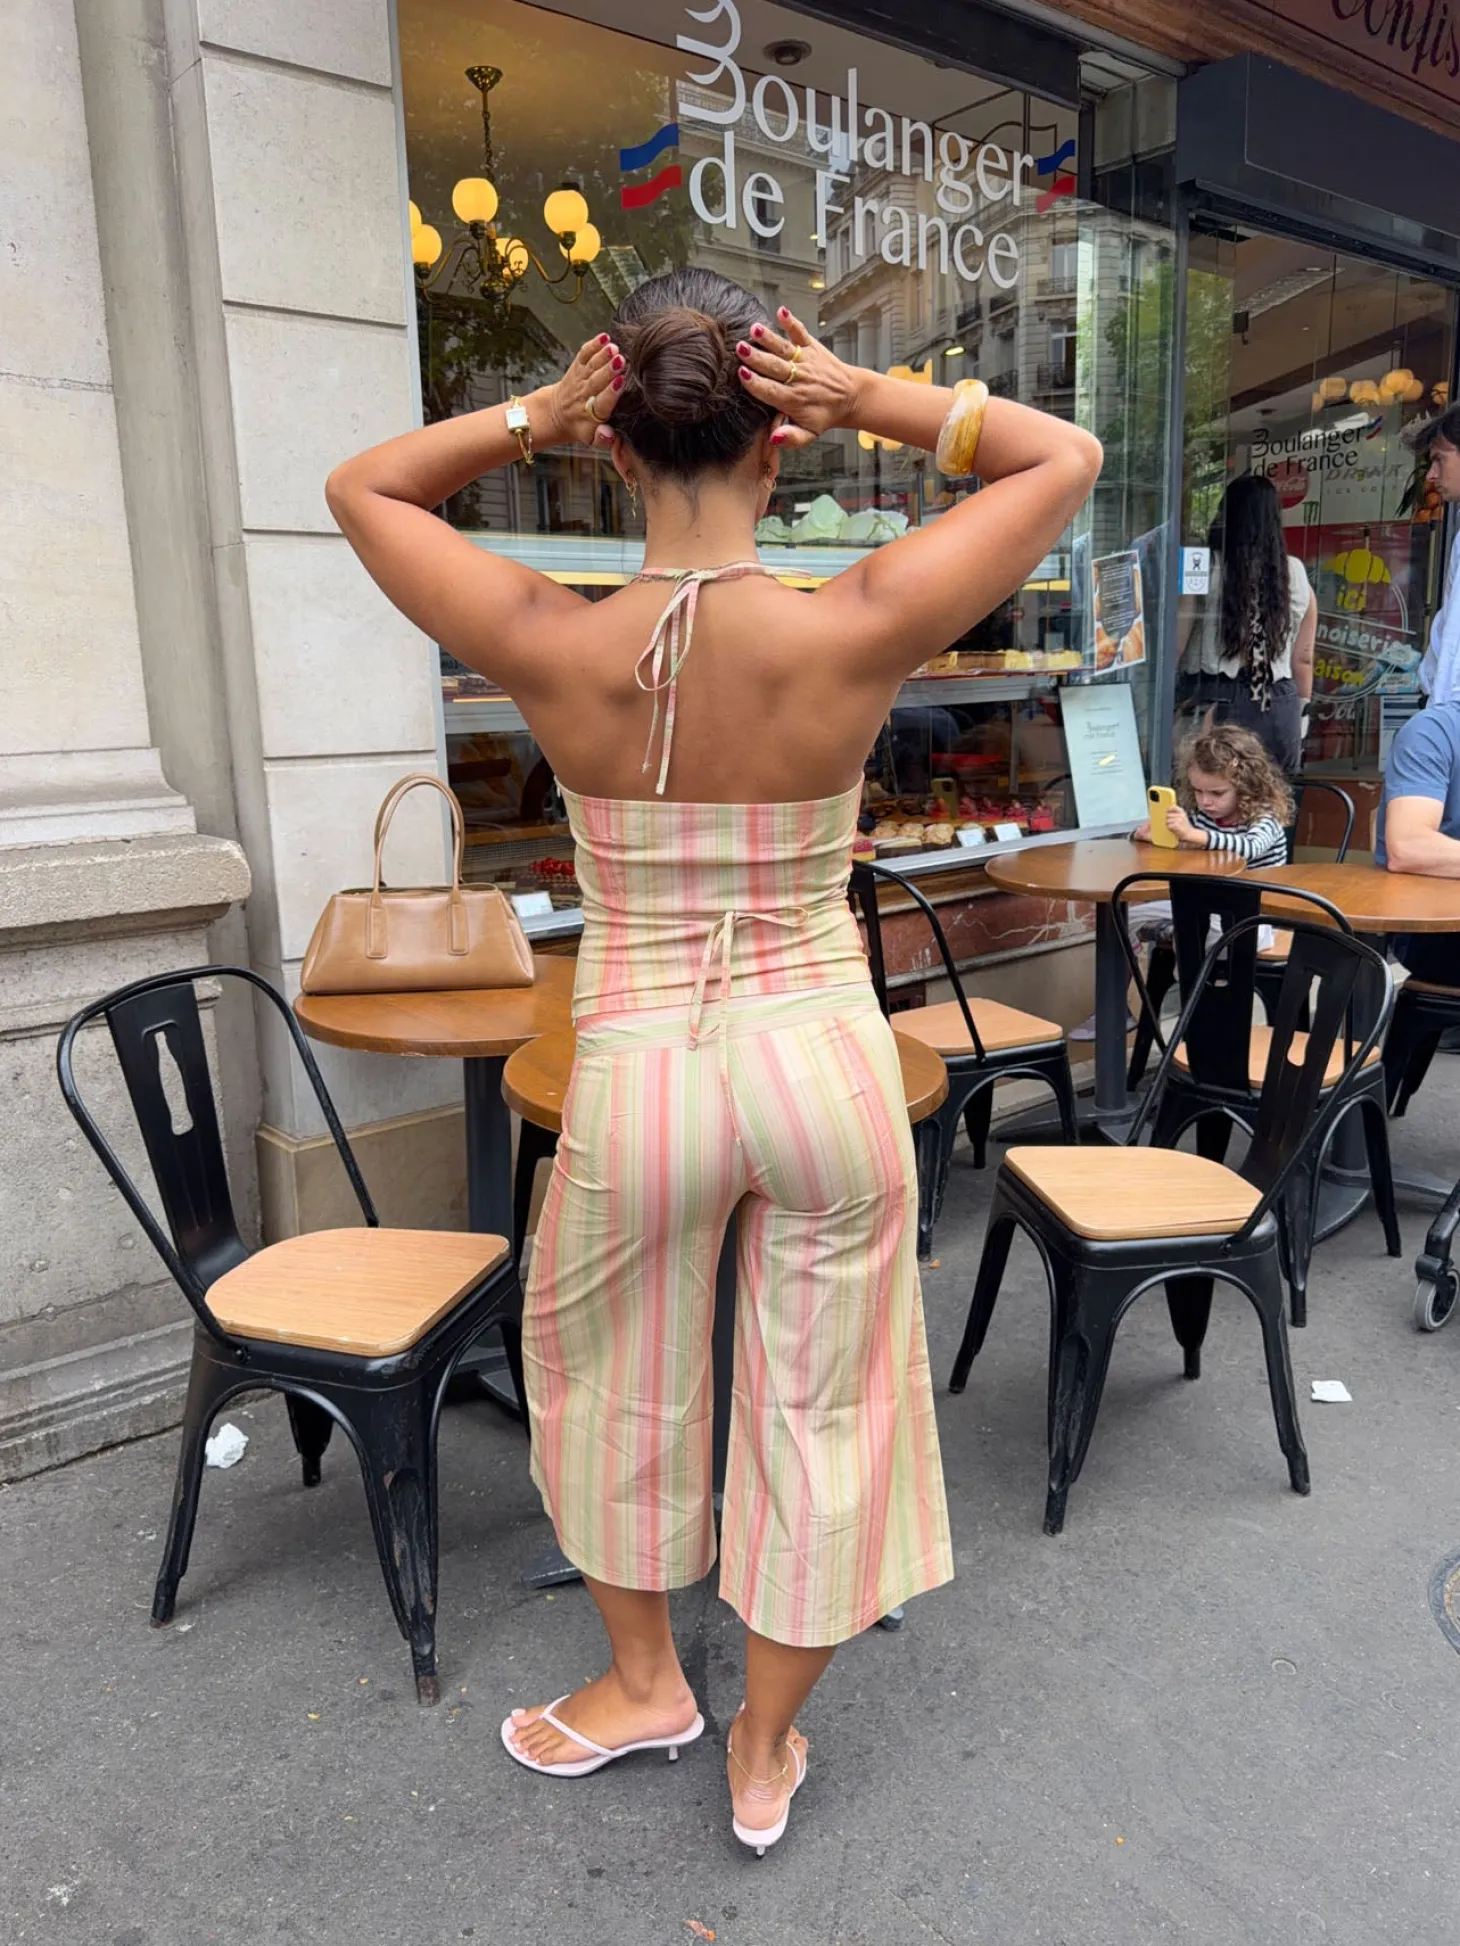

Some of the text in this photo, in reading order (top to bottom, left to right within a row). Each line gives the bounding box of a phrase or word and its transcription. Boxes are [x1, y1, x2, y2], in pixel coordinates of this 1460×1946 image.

[1332, 0, 1460, 77] onfis
[676, 0, 1034, 214] Boulanger
[688, 131, 1019, 288] de France
[1251, 426, 1366, 458] Boulanger
[1254, 450, 1358, 478] de France
[1314, 658, 1365, 686] aison
